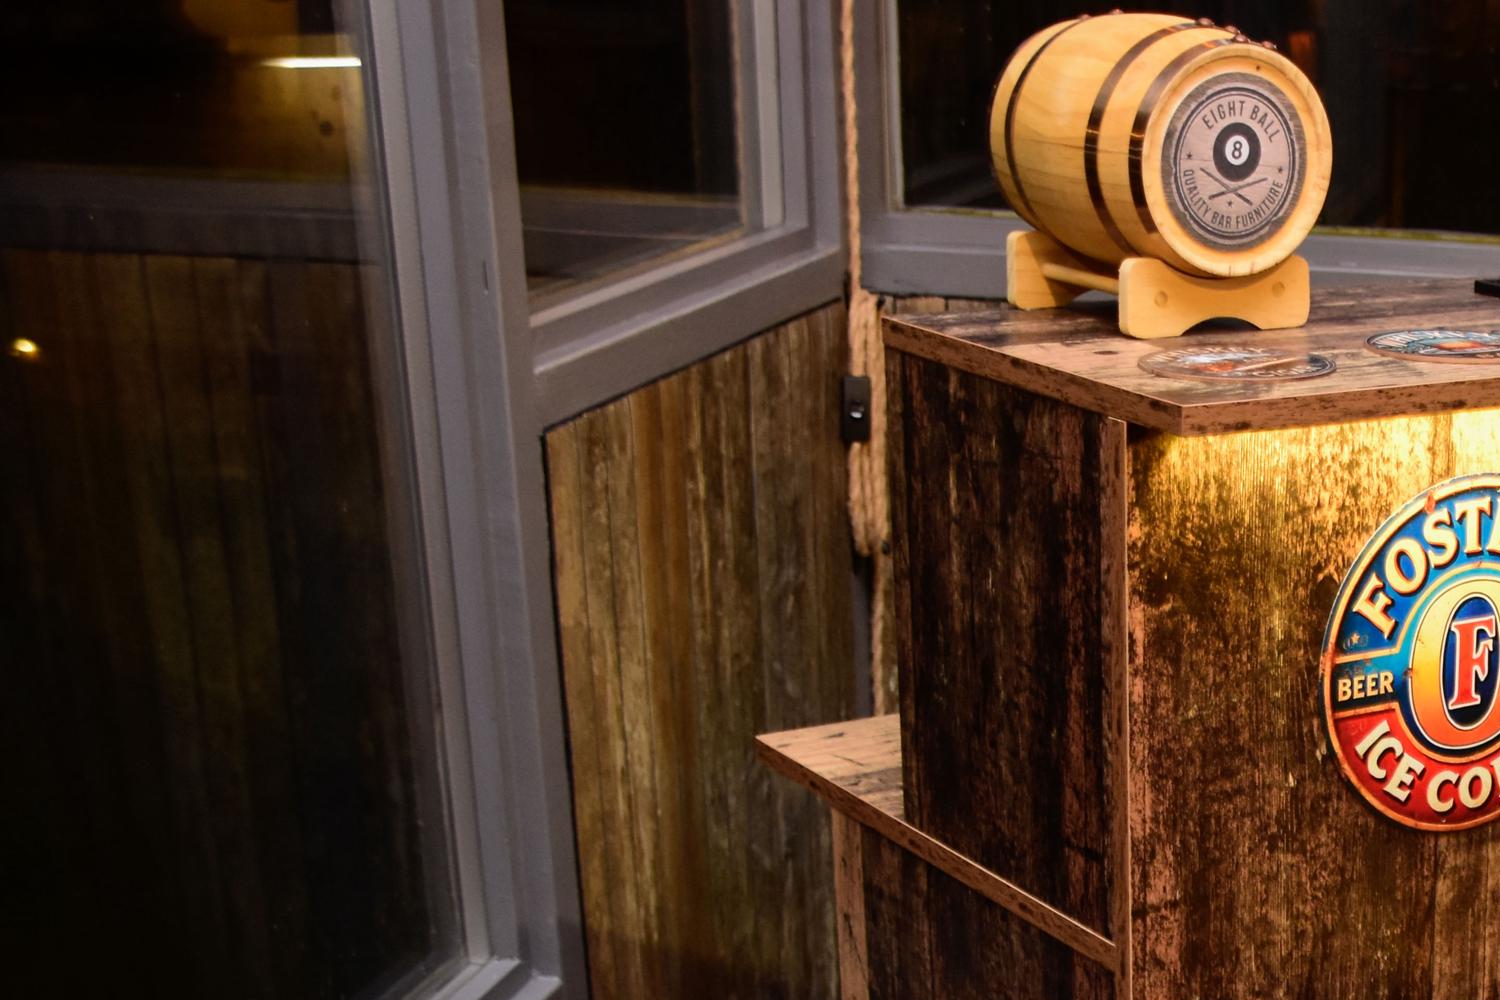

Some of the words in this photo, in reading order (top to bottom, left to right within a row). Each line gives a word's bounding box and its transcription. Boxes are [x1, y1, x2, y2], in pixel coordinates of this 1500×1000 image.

[1202, 100, 1246, 130] EIGHT
[1249, 105, 1281, 144] BALL
[1230, 139, 1244, 160] 8
[1183, 168, 1213, 218] QUALITY
[1210, 210, 1233, 230] BAR
[1234, 180, 1284, 230] FURNITURE
[1337, 671, 1395, 702] BEER
[1354, 719, 1426, 803] ICE
